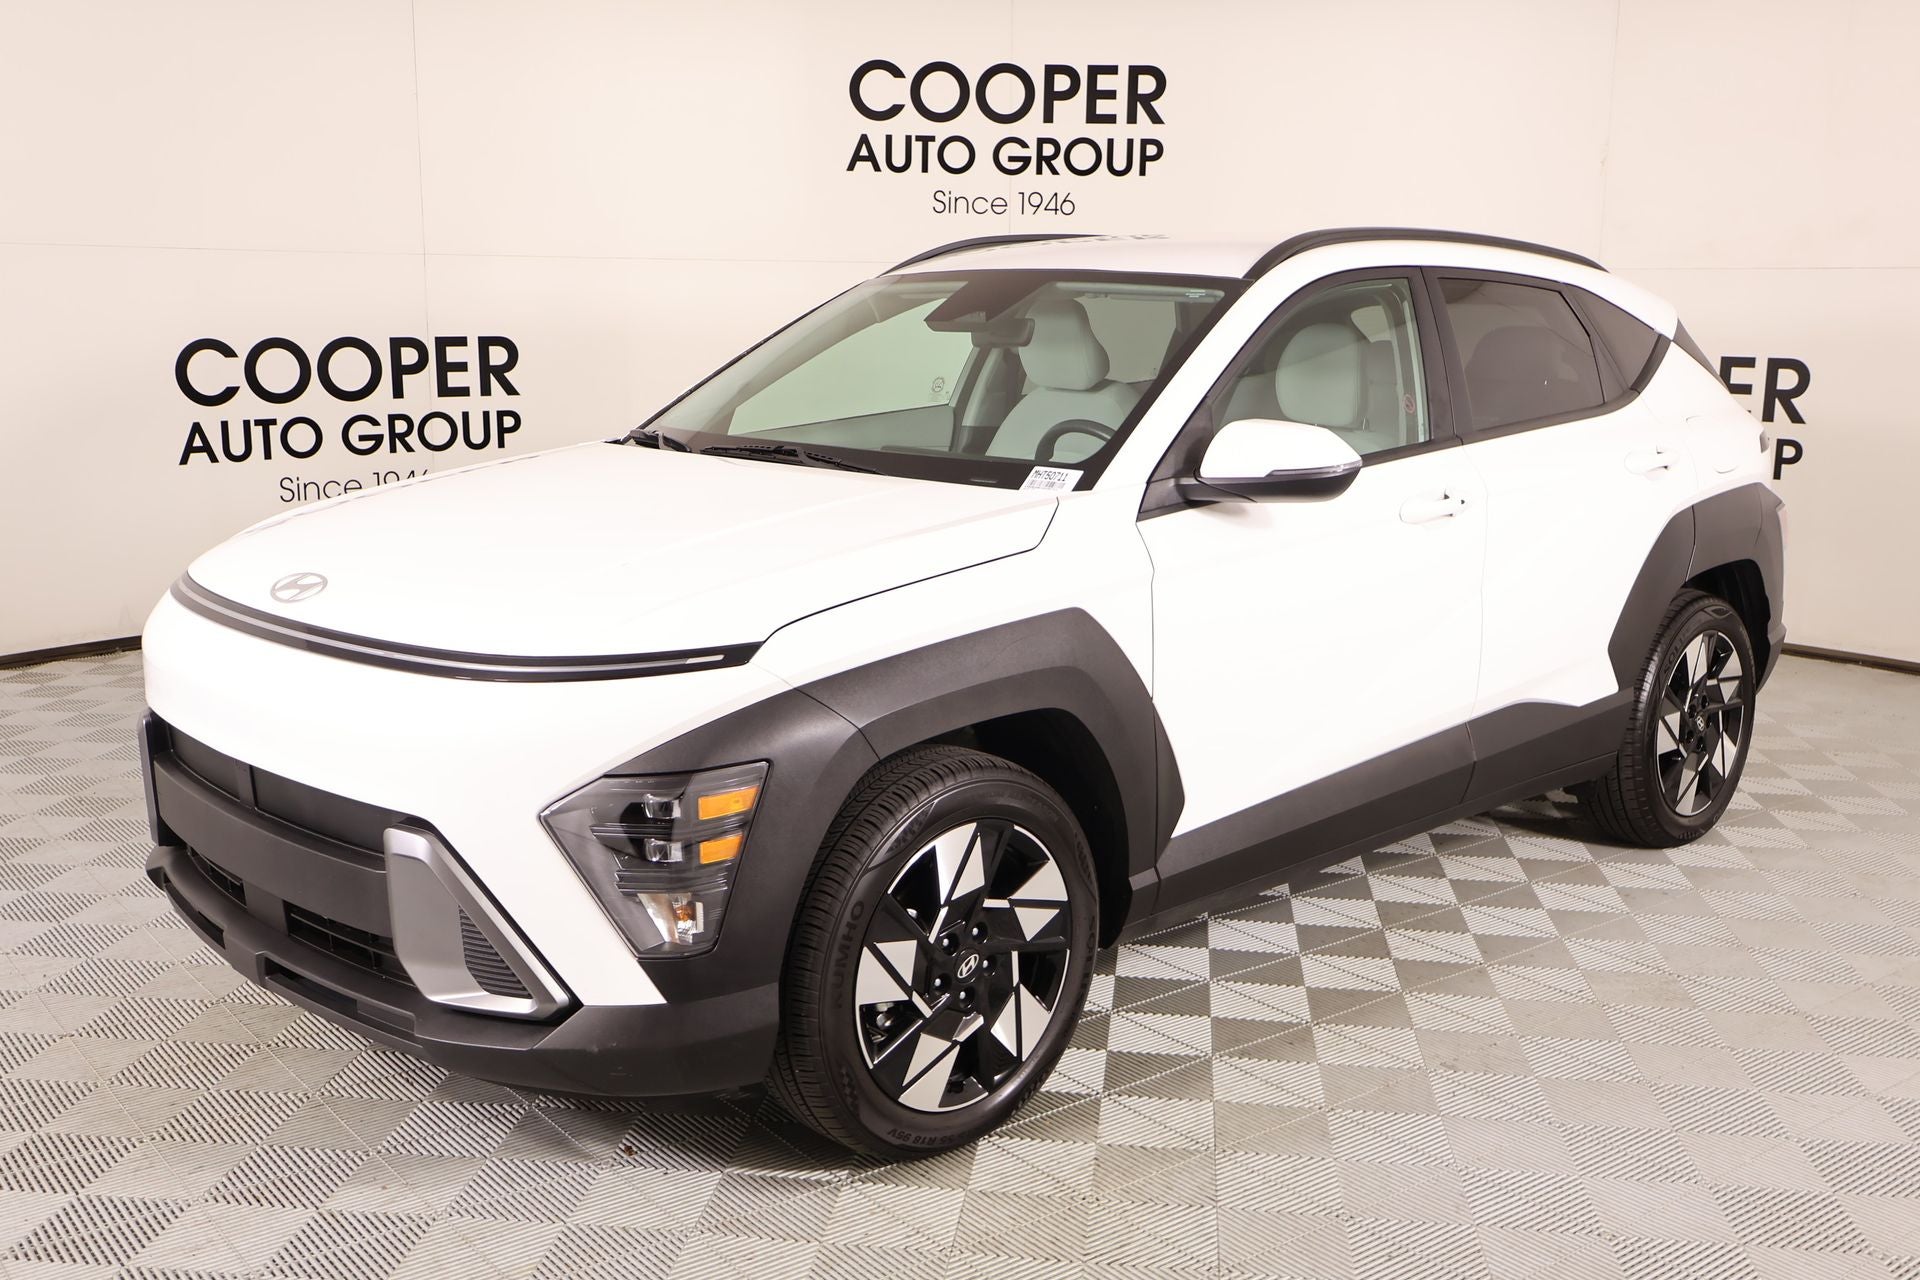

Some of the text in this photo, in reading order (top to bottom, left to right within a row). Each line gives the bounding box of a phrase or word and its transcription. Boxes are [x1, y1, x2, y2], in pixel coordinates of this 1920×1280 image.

[849, 60, 1166, 124] COOPER
[847, 134, 1164, 177] AUTO GROUP
[933, 190, 1075, 215] Since 1946
[175, 336, 520, 407] COOPER
[179, 410, 521, 465] AUTO GROUP
[280, 477, 362, 502] Since
[833, 901, 865, 1009] KUMHO
